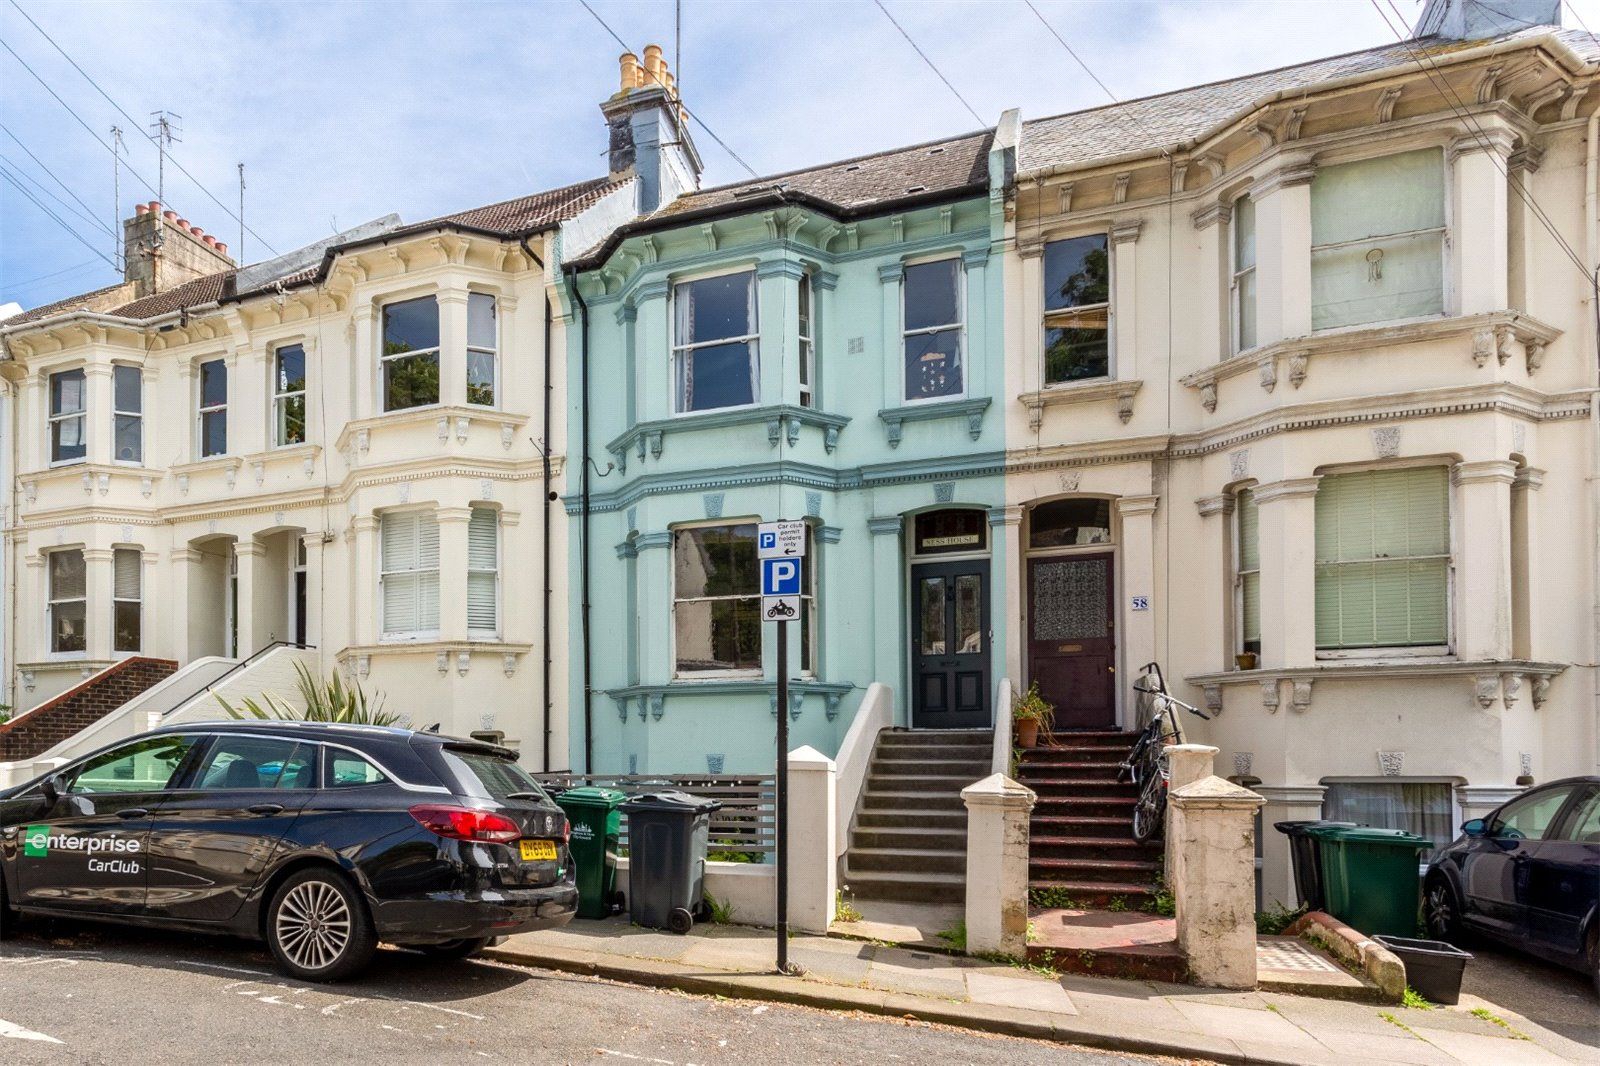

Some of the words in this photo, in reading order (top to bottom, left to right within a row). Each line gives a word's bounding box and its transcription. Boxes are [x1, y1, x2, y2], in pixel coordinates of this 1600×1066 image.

[764, 535, 773, 547] P
[772, 561, 795, 592] P
[1133, 598, 1148, 608] 58
[26, 833, 140, 855] enterprise
[88, 859, 140, 874] CarClub
